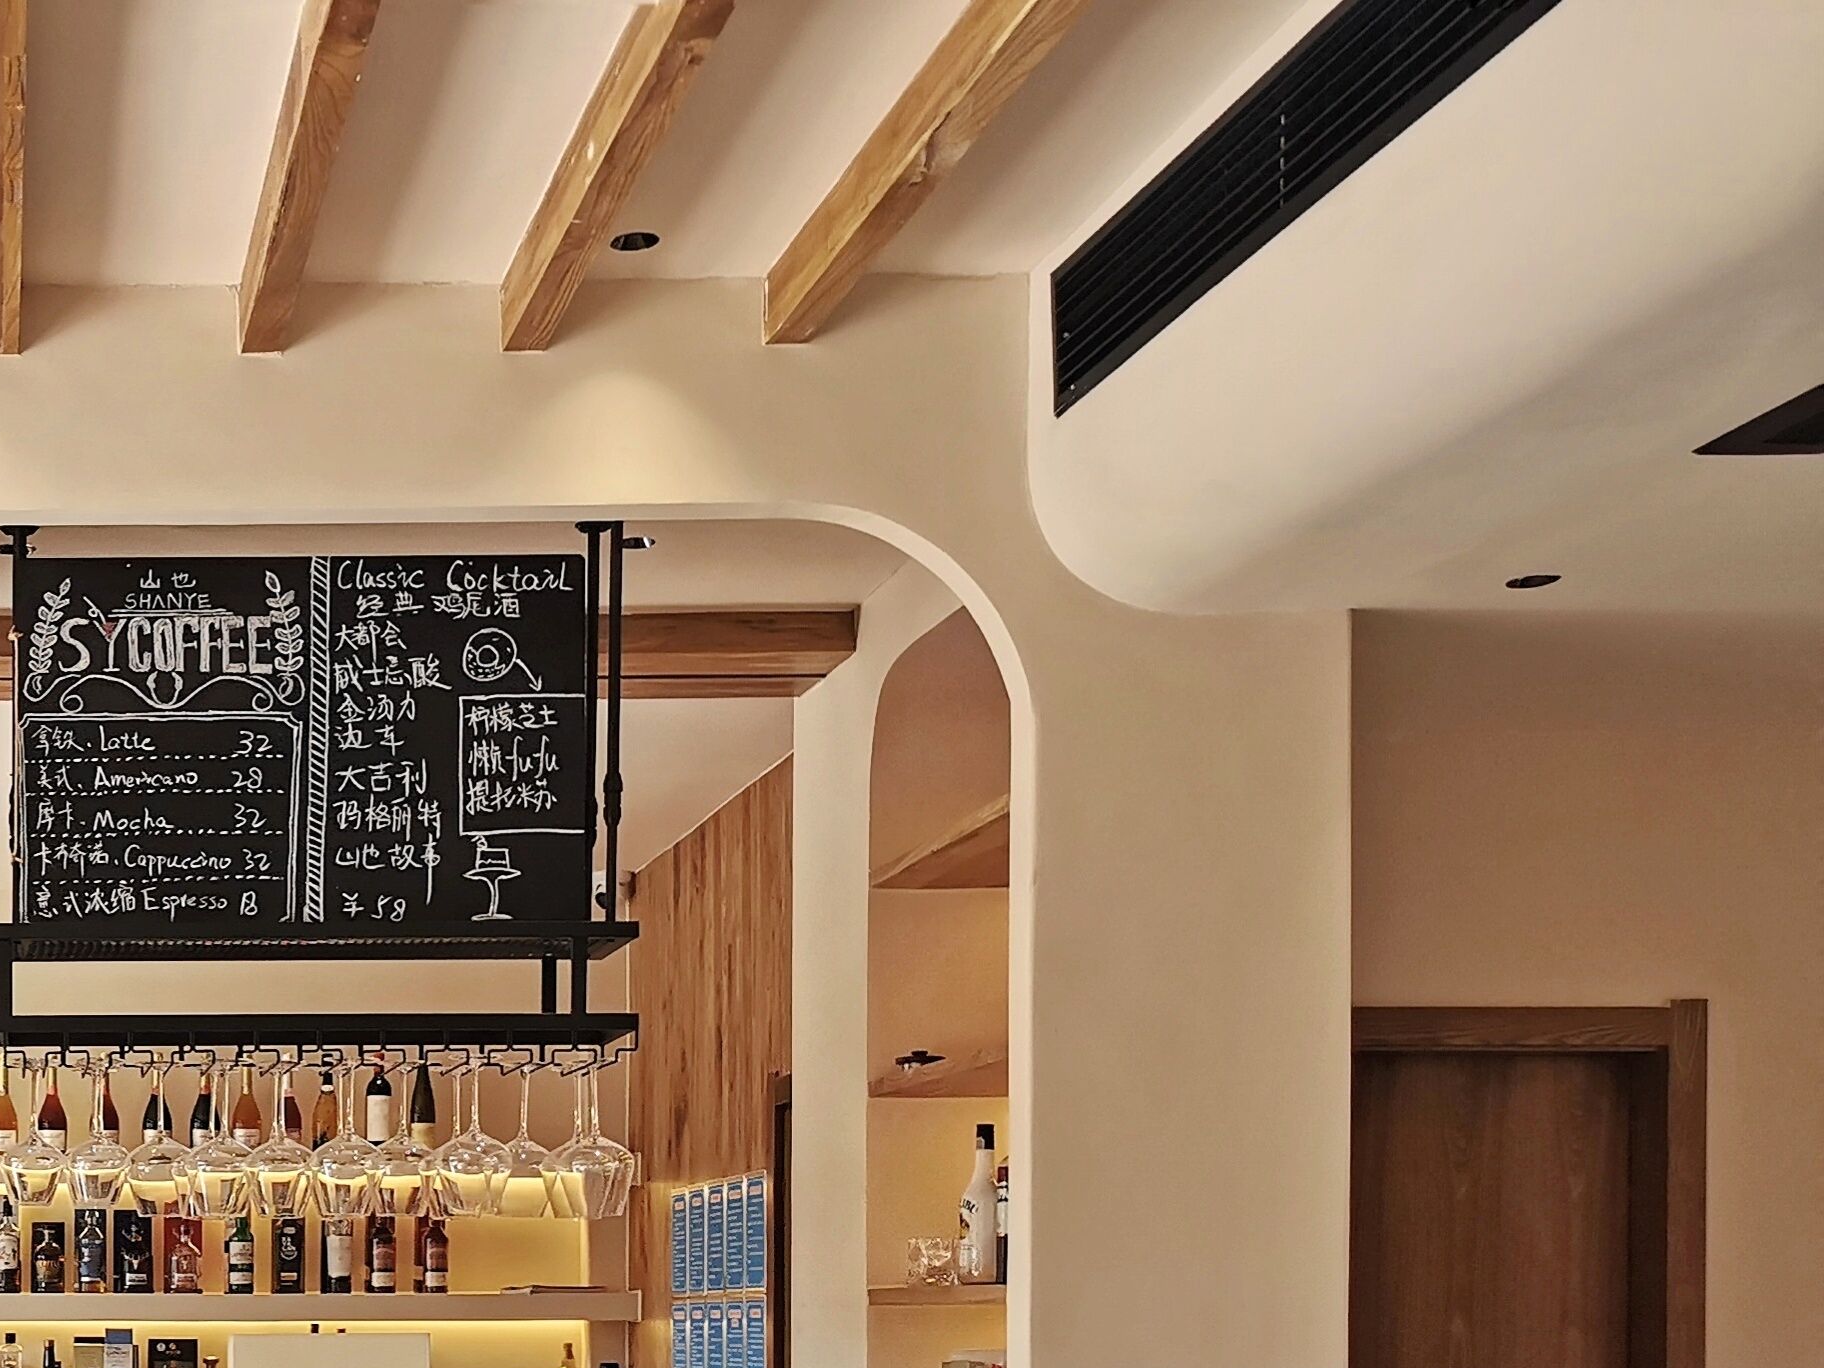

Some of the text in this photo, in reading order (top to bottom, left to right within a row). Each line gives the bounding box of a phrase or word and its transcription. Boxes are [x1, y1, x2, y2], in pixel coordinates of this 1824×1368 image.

[140, 569, 196, 588] 山也
[337, 559, 574, 592] Classic Cocktail
[334, 620, 407, 654] 大都会
[333, 652, 453, 693] 威士忌酸
[336, 690, 416, 723] 金汤力
[234, 730, 274, 754] 32
[93, 766, 199, 790] Americano
[230, 767, 264, 790] 28
[334, 759, 427, 798] 大吉利
[93, 807, 176, 831] Mocha
[234, 803, 268, 828] 32
[242, 849, 272, 871] 32
